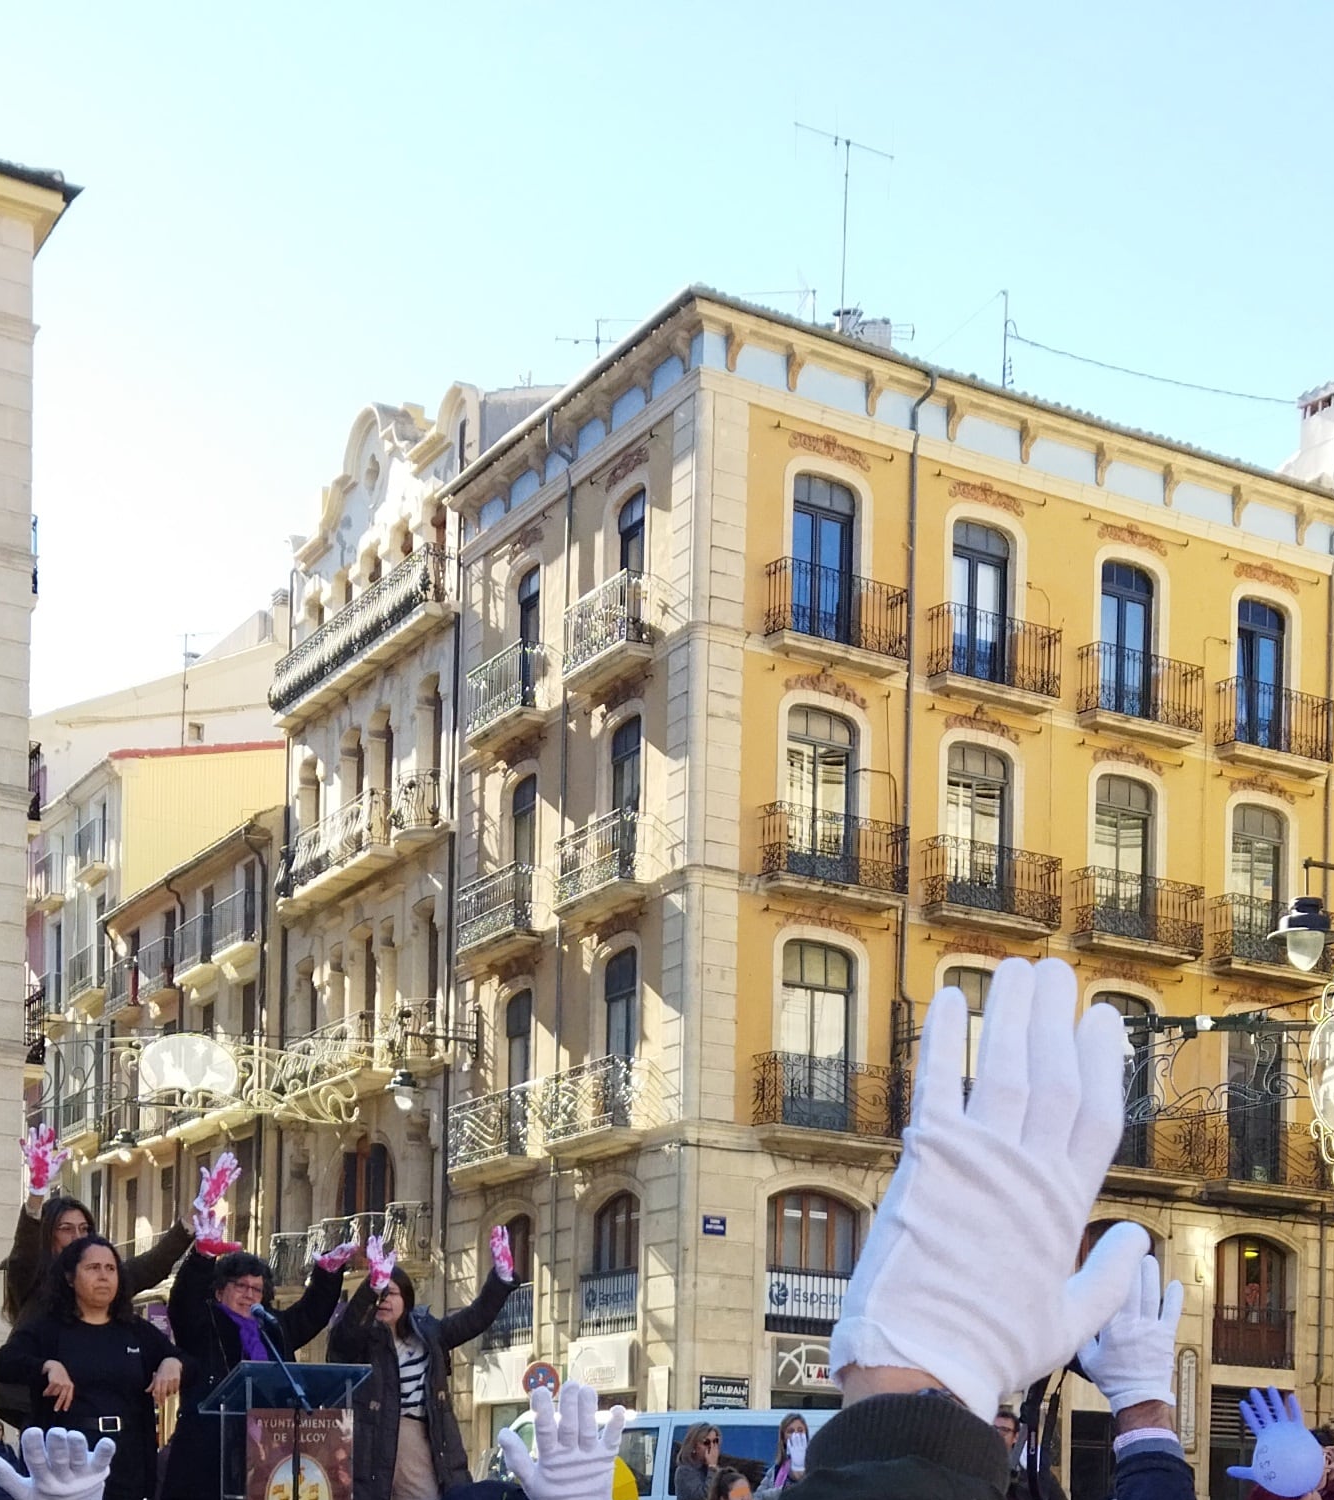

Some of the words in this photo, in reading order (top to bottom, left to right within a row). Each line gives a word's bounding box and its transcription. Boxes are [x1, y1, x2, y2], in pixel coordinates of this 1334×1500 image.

[257, 1419, 338, 1429] AYUNTMIENTO
[273, 1433, 287, 1441] DE
[292, 1433, 327, 1442] LCOY
